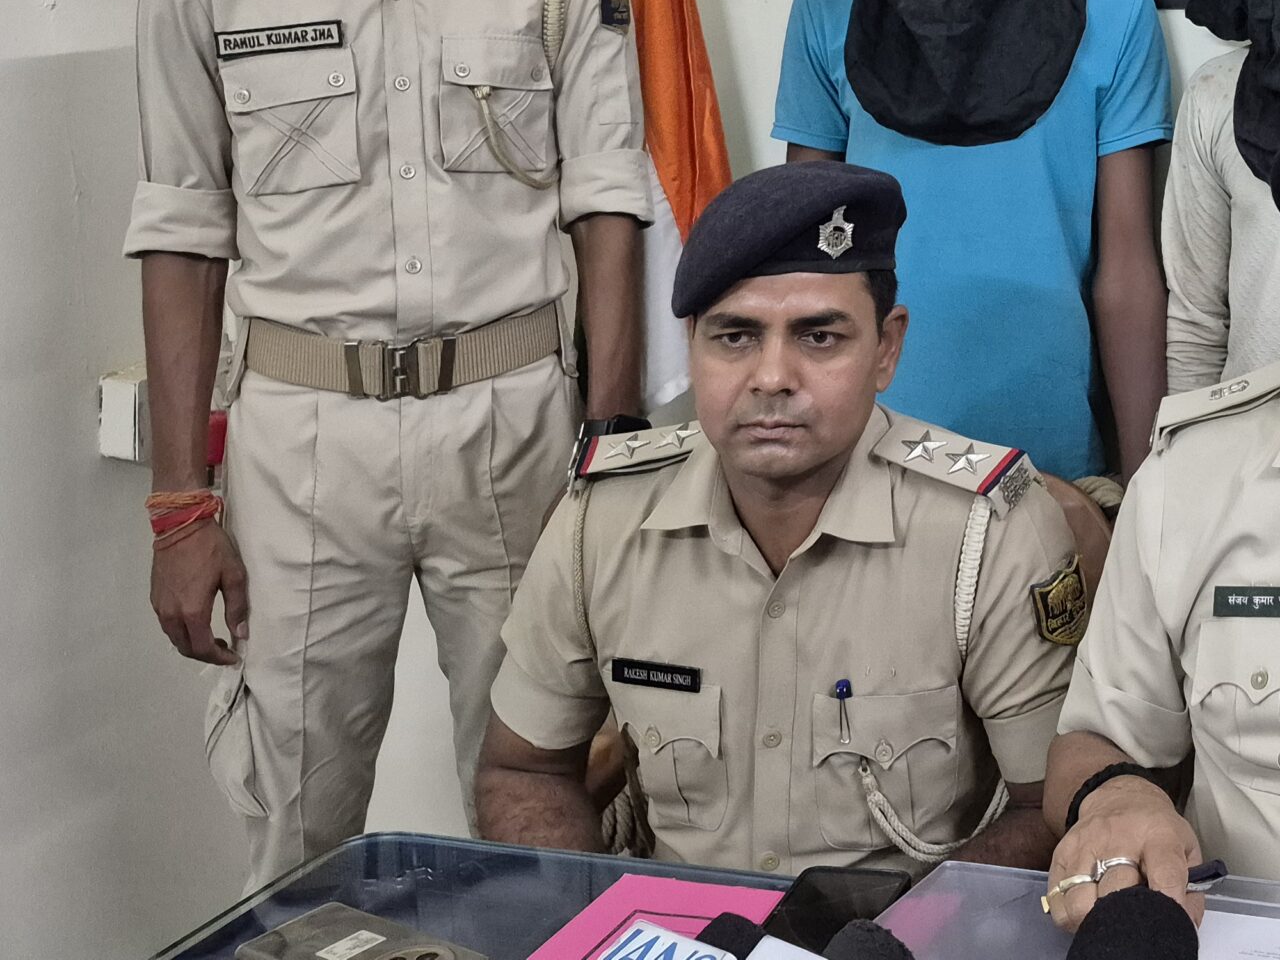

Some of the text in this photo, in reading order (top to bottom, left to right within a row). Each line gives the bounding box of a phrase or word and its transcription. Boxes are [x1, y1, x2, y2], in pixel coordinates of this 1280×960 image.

[223, 27, 334, 51] RAHUL KUMAR JHA
[1228, 594, 1248, 605] संजय
[1252, 595, 1274, 609] कुमार
[624, 667, 691, 686] RAKESH KUMAR SINGH
